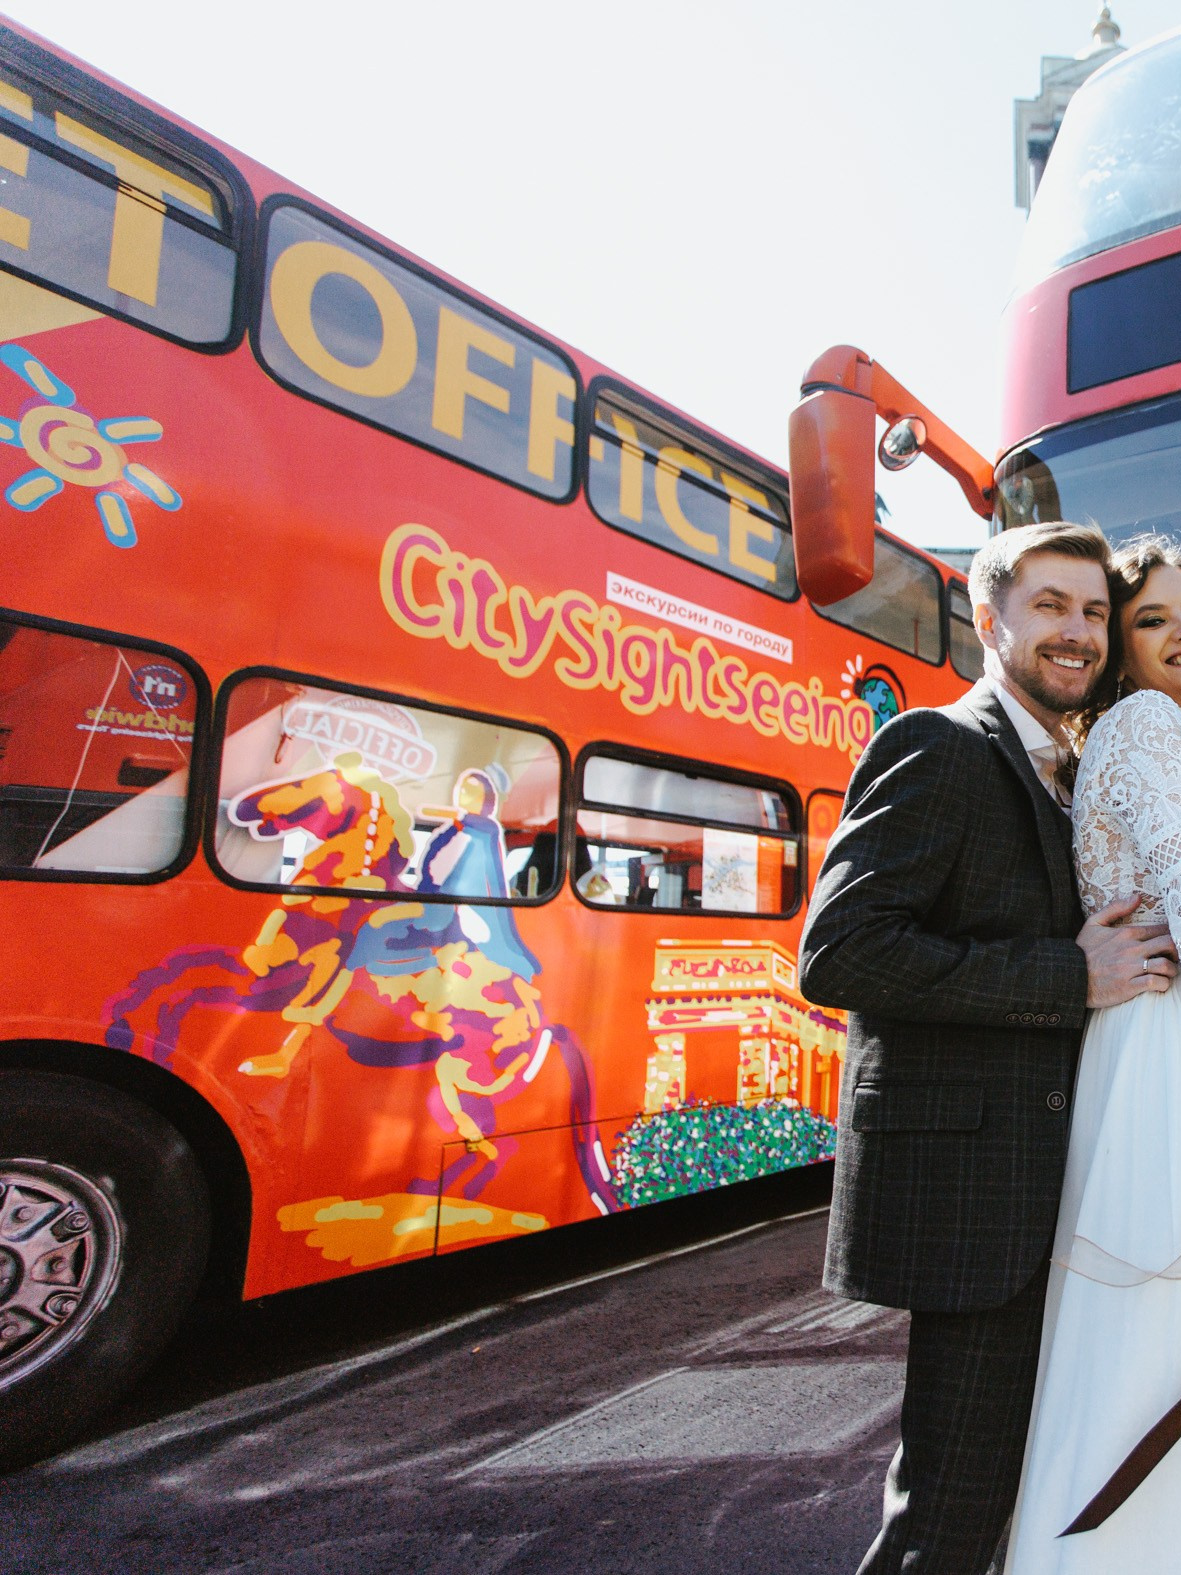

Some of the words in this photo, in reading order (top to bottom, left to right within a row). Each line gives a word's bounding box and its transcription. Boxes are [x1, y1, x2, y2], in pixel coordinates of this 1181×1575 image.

[270, 241, 778, 584] OFFICE
[611, 581, 708, 625] экскурсии
[713, 618, 733, 634] по
[737, 627, 789, 657] городу
